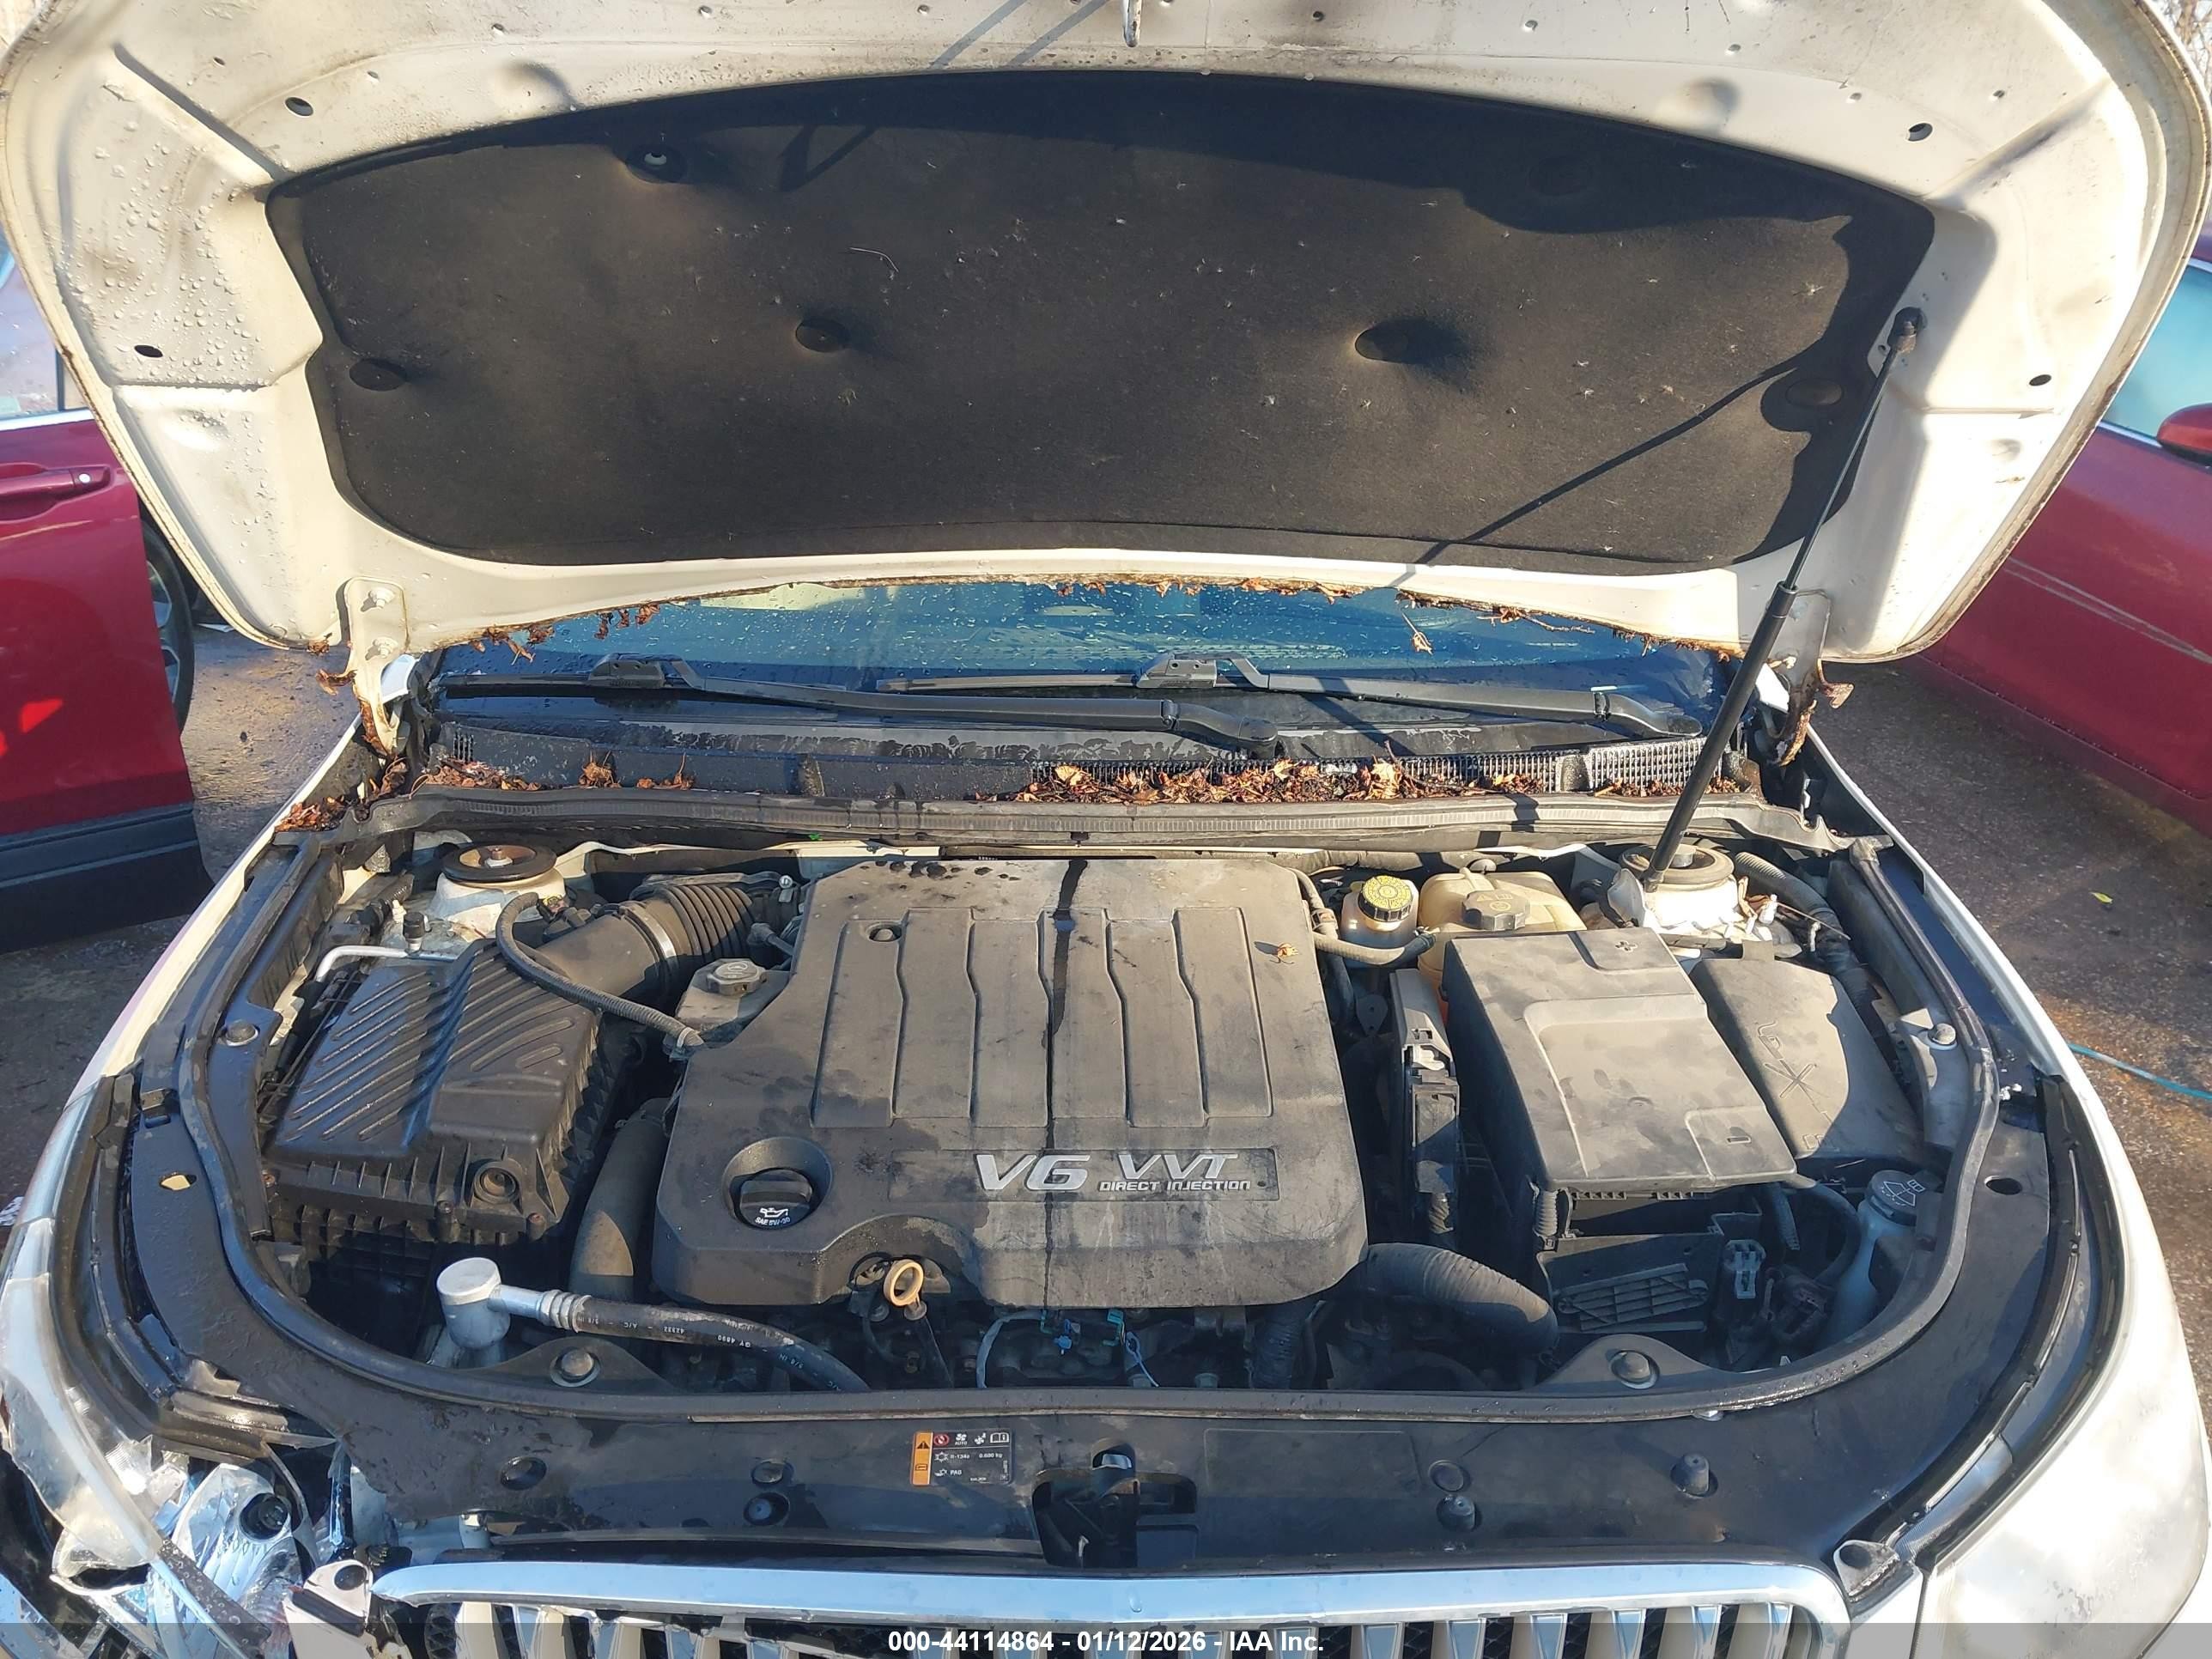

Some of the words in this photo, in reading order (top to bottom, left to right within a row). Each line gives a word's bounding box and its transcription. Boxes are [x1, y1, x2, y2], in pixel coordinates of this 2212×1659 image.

[975, 1153, 1091, 1191] V6
[1118, 1153, 1239, 1180] VVT
[1098, 1181, 1160, 1192] DIRECT
[1166, 1180, 1251, 1191] INJECTION
[755, 1217, 769, 1225] SAE
[769, 1217, 791, 1226] 5W-30
[623, 1322, 638, 1330] A/C
